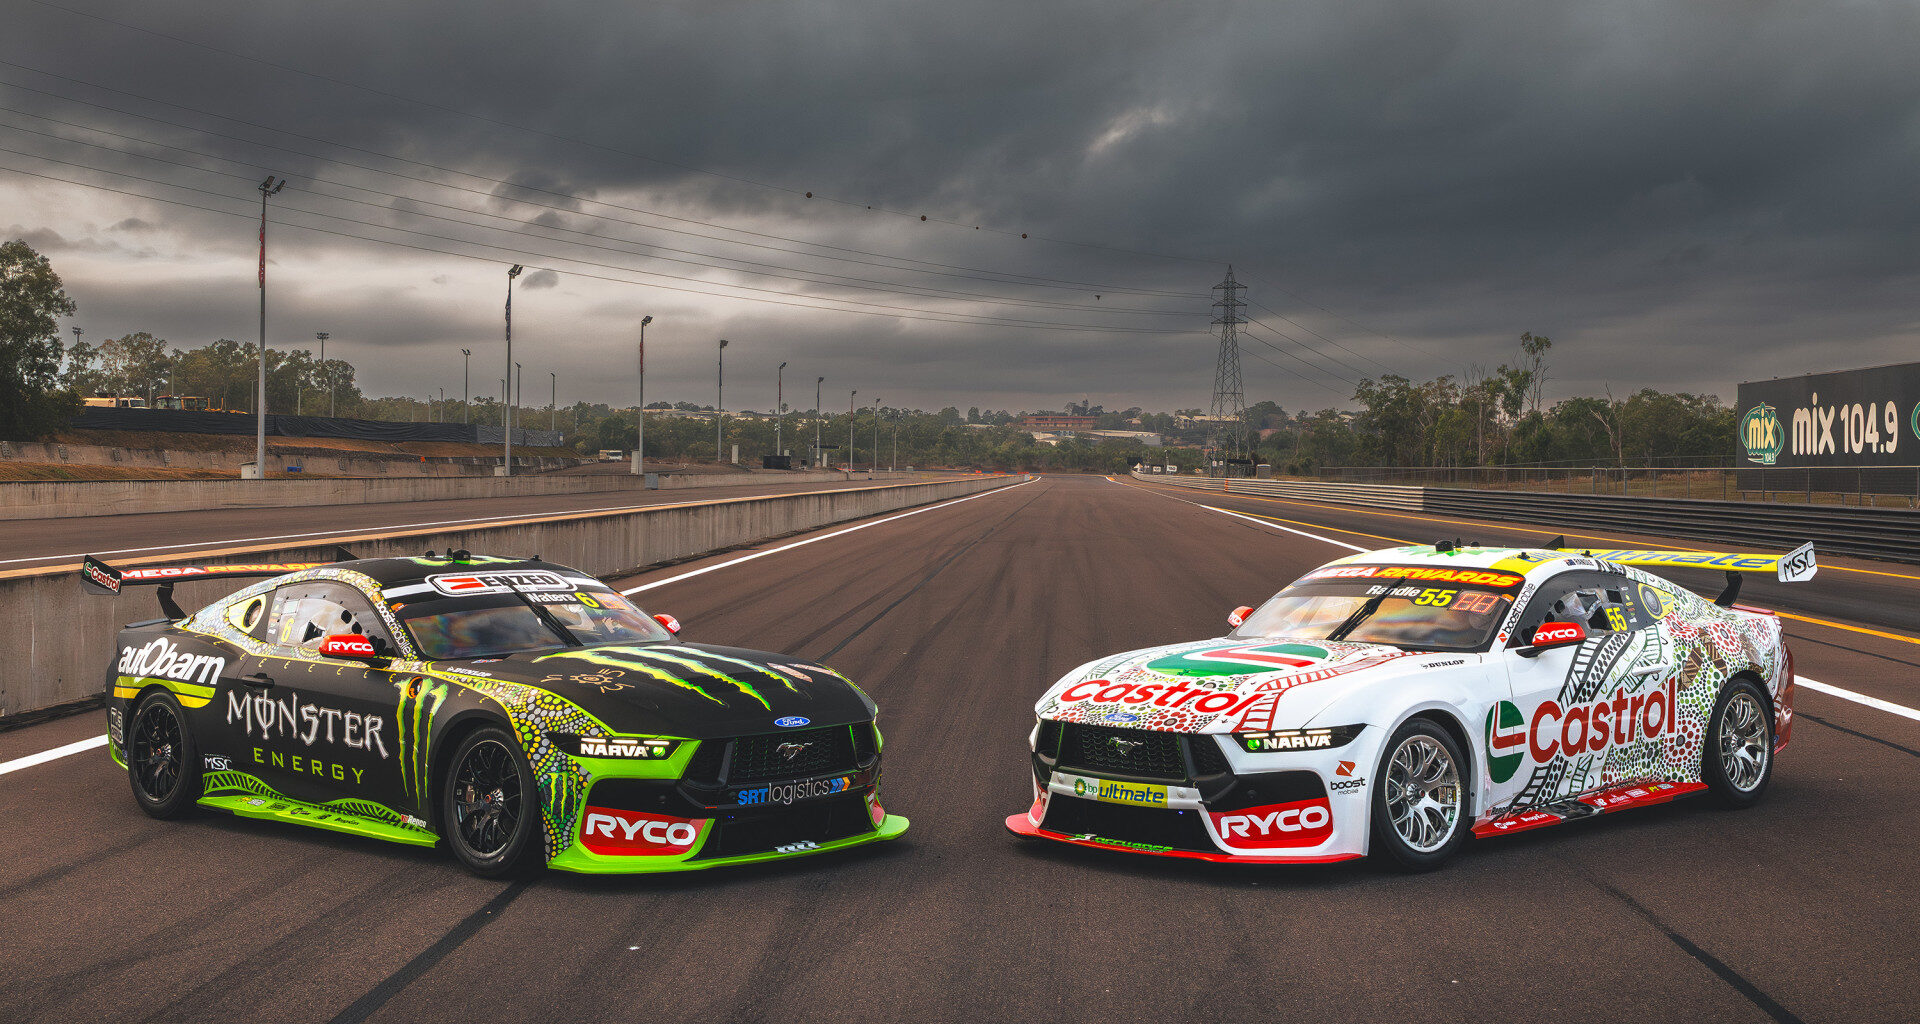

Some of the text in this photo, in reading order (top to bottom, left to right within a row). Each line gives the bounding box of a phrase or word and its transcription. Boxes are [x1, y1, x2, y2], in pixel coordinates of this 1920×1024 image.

[1748, 407, 1775, 450] mix
[1792, 392, 1898, 455] mix 104.9
[121, 567, 205, 579] MEGA
[1783, 548, 1816, 581] MSC
[90, 564, 120, 592] Castrol
[479, 574, 559, 587] ENZED
[1374, 567, 1521, 586] REWARDS
[574, 592, 599, 608] 6
[1366, 585, 1420, 597] Randle
[1415, 589, 1456, 607] 55
[1606, 607, 1627, 632] 55
[281, 618, 295, 643] 6
[1533, 629, 1577, 642] RYCO
[328, 641, 374, 652] RYCO
[452, 667, 492, 678] DUNLOP
[1428, 659, 1464, 668] DUNLOP
[1060, 679, 1265, 717] Castrol
[226, 688, 389, 760] MONSTER
[1530, 676, 1676, 763] Castrol
[580, 743, 648, 758] NARVA
[1264, 735, 1331, 750] NARVA
[204, 757, 233, 771] MSC
[254, 747, 365, 784] ENERGY
[1330, 777, 1366, 790] boost
[1087, 783, 1164, 804] bp ultimate
[585, 813, 696, 846] RYCO
[1221, 805, 1329, 839] RYCO
